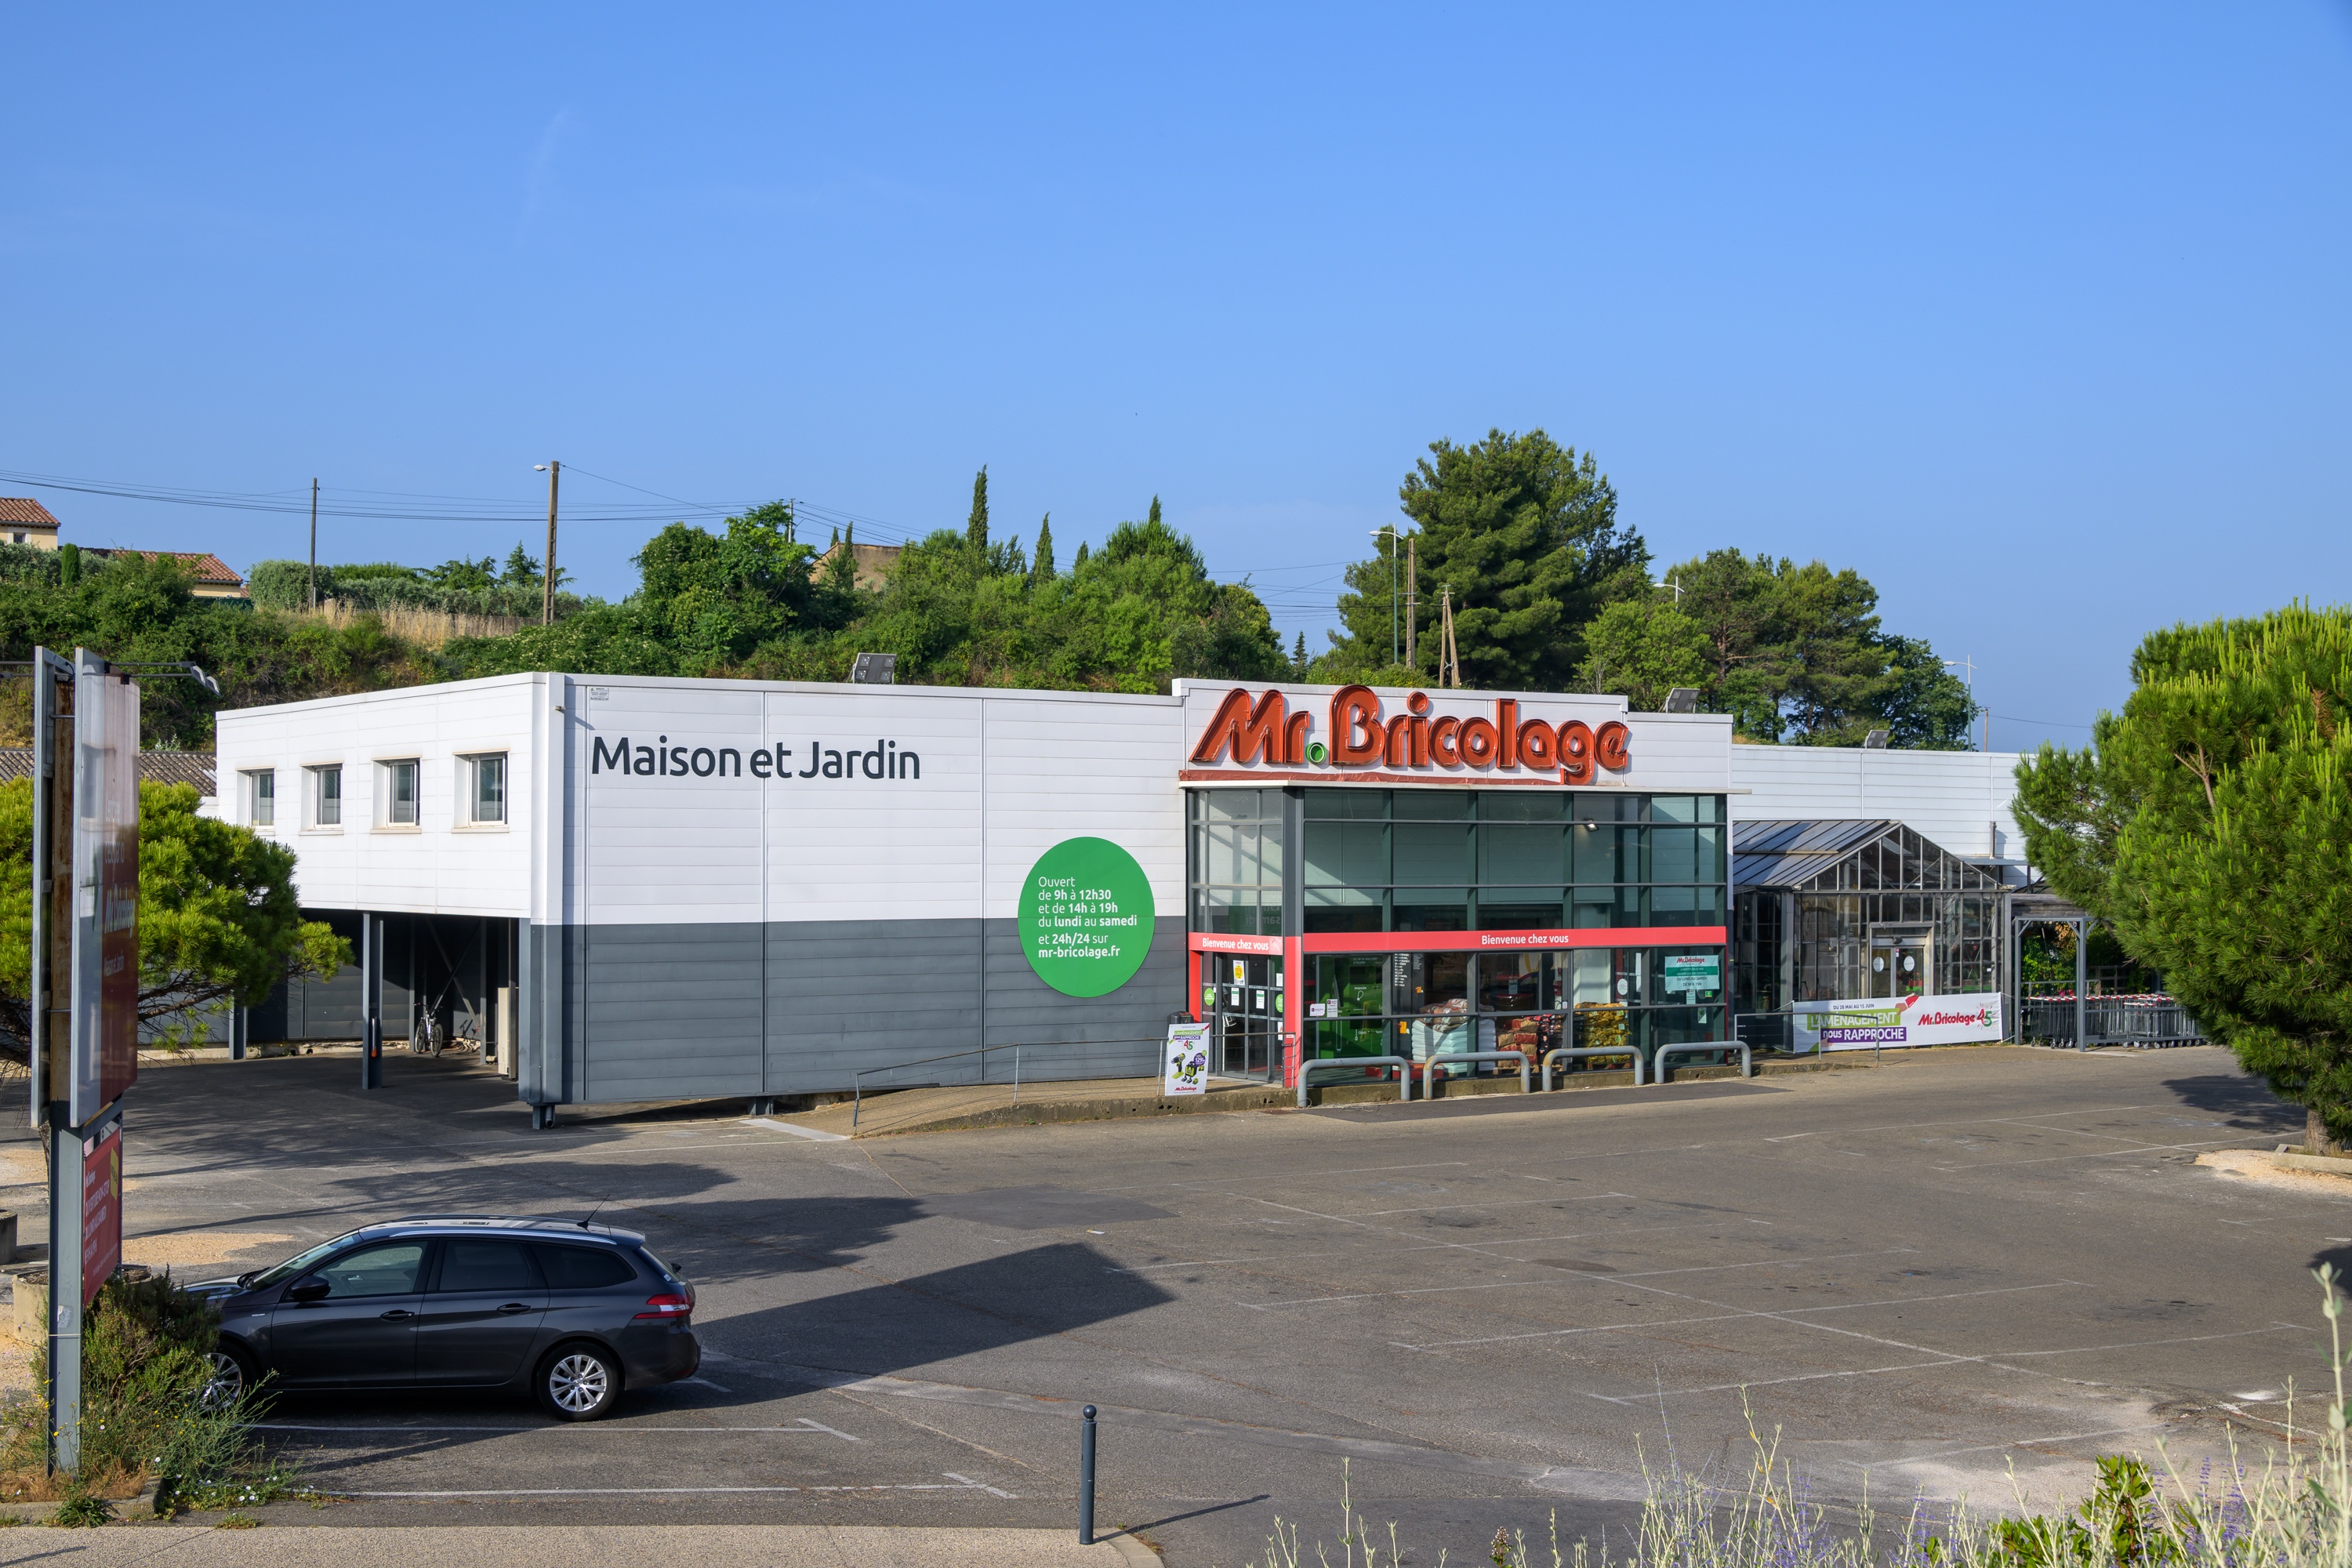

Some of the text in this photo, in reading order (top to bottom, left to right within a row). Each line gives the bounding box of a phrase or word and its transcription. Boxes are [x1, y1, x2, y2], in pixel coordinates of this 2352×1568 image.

[592, 735, 920, 779] Maison et Jardin
[1039, 877, 1075, 887] Ouvert
[1039, 889, 1111, 900] de 9h à 12h30
[1039, 902, 1118, 913] et de 14h à 19h
[1039, 916, 1051, 927] du
[1054, 915, 1081, 927] lundi
[1099, 914, 1137, 926] samedi
[1039, 935, 1049, 944] et
[1052, 932, 1090, 946] 24h/24
[1203, 937, 1235, 949] Bienvenue
[1237, 938, 1251, 949] chez
[1482, 935, 1526, 945] Bienvenue
[1528, 934, 1547, 943] chez
[1039, 945, 1120, 959] mr-bricolage.fr
[1811, 1011, 1896, 1028] L'AMÉNAGEMENT
[1976, 1009, 1993, 1027] 45
[1844, 1029, 1904, 1040] RAPPROCHE
[1184, 1040, 1193, 1050] 45
